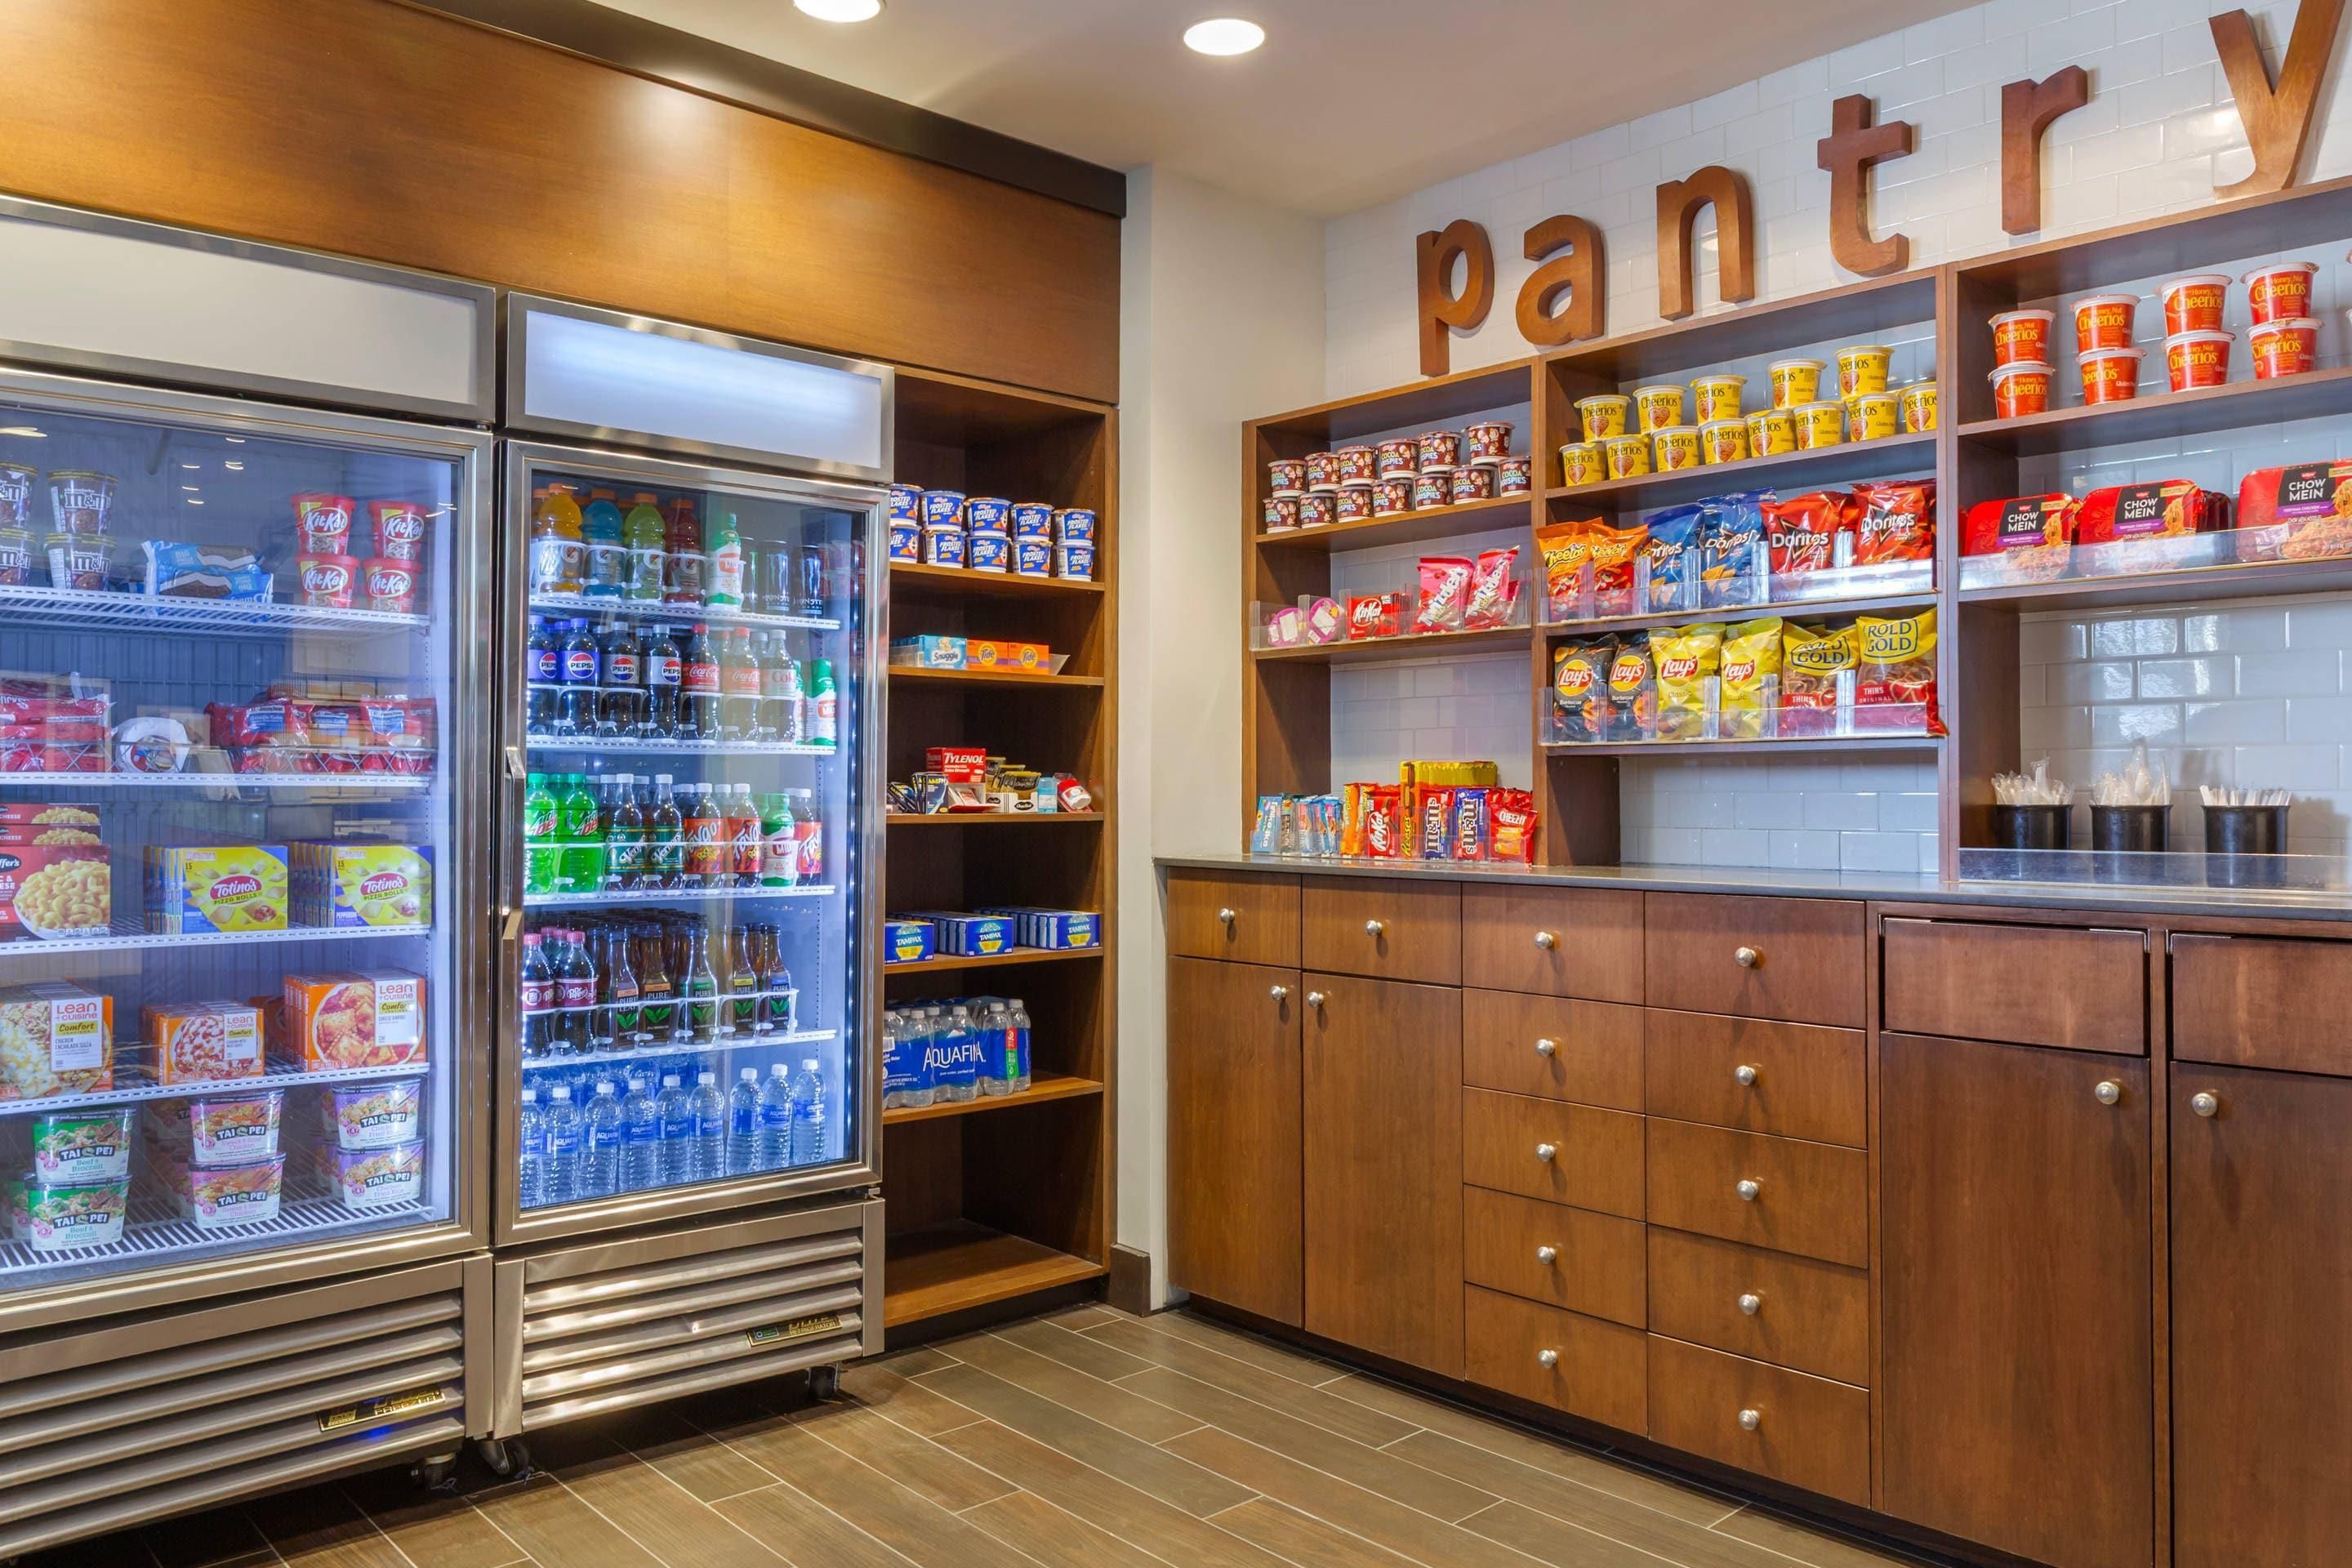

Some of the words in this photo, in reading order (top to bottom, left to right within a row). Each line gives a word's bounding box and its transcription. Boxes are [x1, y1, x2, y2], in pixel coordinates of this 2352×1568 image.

[1415, 0, 2340, 376] pantry
[2254, 283, 2306, 301] Cheerios
[2173, 296, 2223, 310] Cheerios
[2078, 314, 2125, 331] Cheerios
[1995, 328, 2038, 345] Cheerios
[2252, 340, 2301, 359] Cheerios
[2169, 350, 2217, 369] Cheerios
[2003, 383, 2047, 397] Cheerios
[1641, 395, 1677, 409] Cheerios
[1706, 429, 1744, 443] Cheerios
[1657, 437, 1693, 450] Cheerios
[2288, 478, 2327, 491] CHOW
[2288, 488, 2323, 501] MEIN
[2124, 497, 2158, 510] CHOW
[2007, 511, 2039, 523] CHOW
[2124, 506, 2155, 519] MEIN
[1861, 513, 1915, 532] Doritos
[2007, 520, 2037, 532] MEIN
[1771, 532, 1829, 549] Doritos
[1868, 619, 1912, 637] ROLD
[1868, 637, 1912, 653] GOLD
[933, 651, 959, 662] Snuggle
[980, 648, 996, 660] Tide
[1022, 651, 1036, 663] Tide
[1797, 651, 1845, 664] GOLD
[1611, 662, 1642, 681] Lay's
[1662, 655, 1697, 678] Lay's
[1723, 659, 1754, 680] Lay's
[1558, 667, 1592, 688] Lay's
[1863, 686, 1884, 694] THINS
[944, 752, 984, 764] TYLENOL
[214, 879, 256, 898] Totino's
[364, 876, 404, 893] Totino's
[1067, 924, 1090, 933] TAMPAX
[896, 936, 922, 945] TAMPAX
[979, 932, 1001, 941] TAMPAX
[380, 984, 412, 994] Lean
[648, 991, 669, 1000] PURE
[56, 1002, 97, 1013] Lean
[227, 1016, 253, 1024] Lean
[59, 1022, 95, 1032] Comfort
[361, 1117, 378, 1126] TAI
[390, 1113, 406, 1121] PEI
[216, 1129, 235, 1139] TAI
[248, 1125, 265, 1134] PEI
[60, 1150, 80, 1160] TAI
[96, 1146, 114, 1156] PEI
[366, 1177, 383, 1186] TAI
[395, 1173, 410, 1181] PEI
[218, 1196, 237, 1205] TAI
[250, 1192, 266, 1200] PEI
[54, 1217, 74, 1227] TAI
[90, 1214, 107, 1223] PEI
